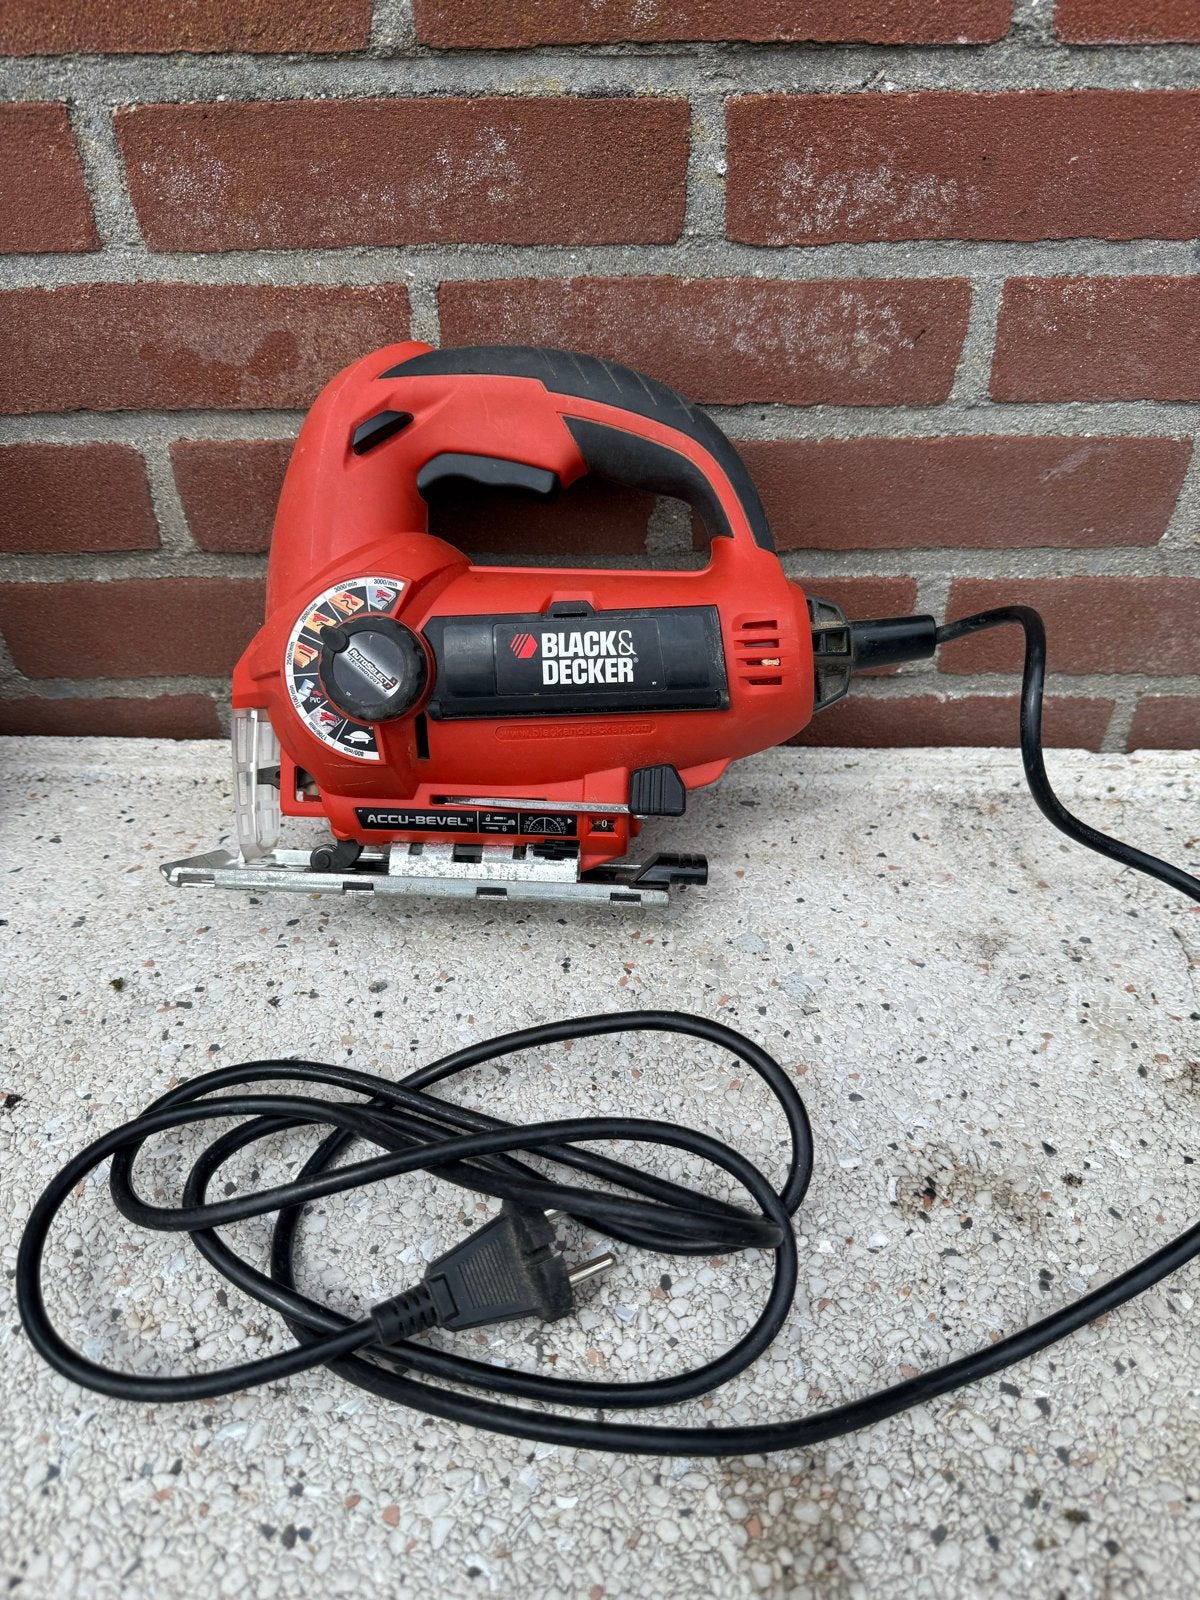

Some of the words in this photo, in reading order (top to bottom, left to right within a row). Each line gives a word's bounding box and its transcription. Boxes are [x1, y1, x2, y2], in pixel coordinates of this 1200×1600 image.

[373, 578, 398, 588] 3000/min
[349, 657, 381, 685] TECHNOLOGY
[309, 696, 321, 704] PVC
